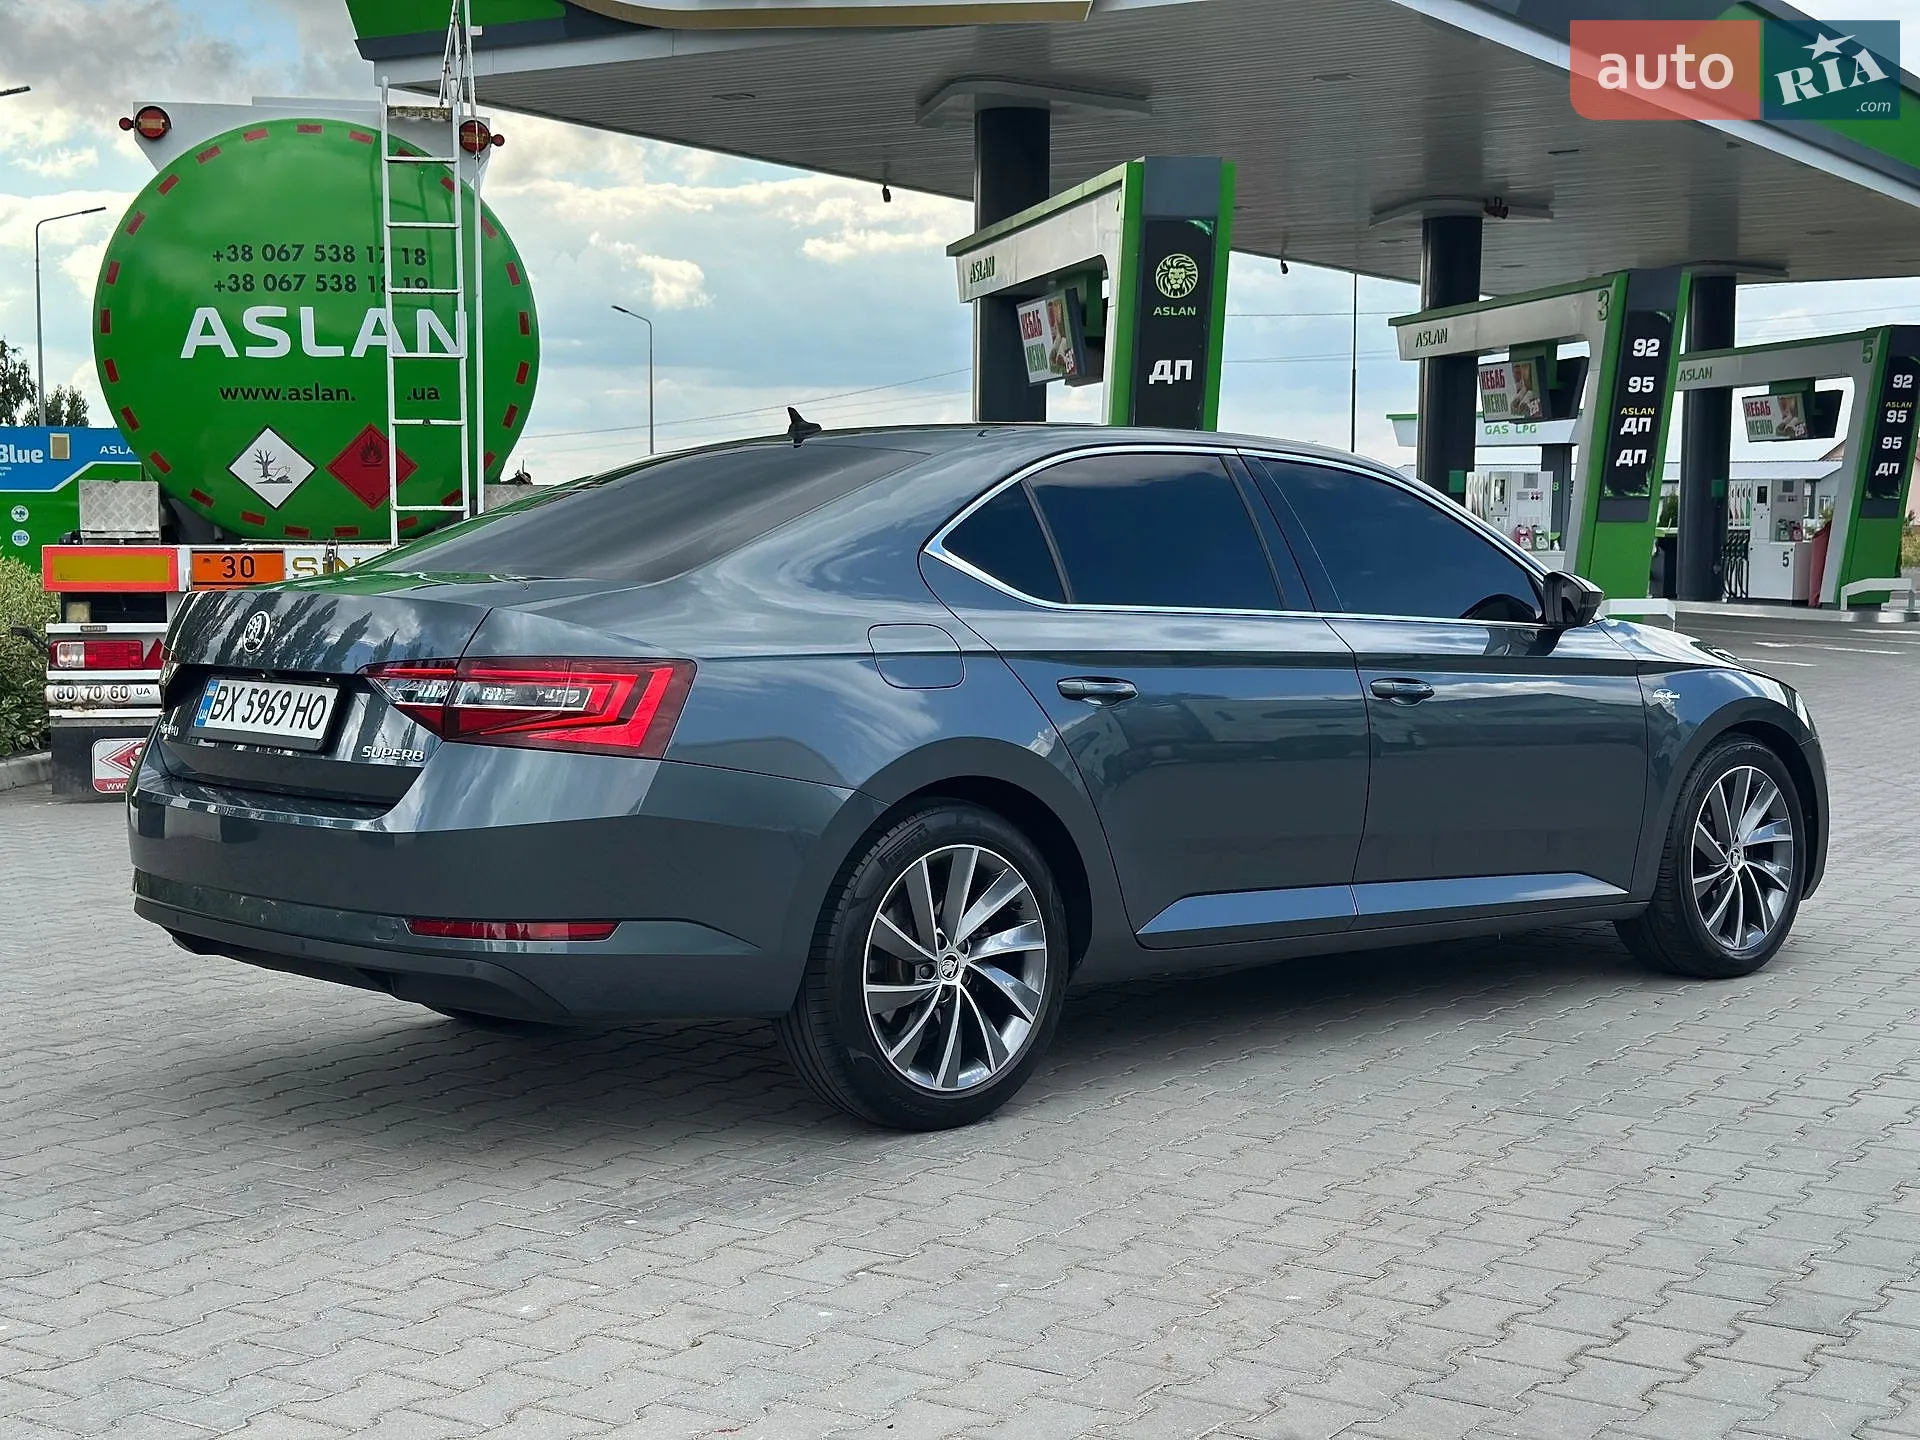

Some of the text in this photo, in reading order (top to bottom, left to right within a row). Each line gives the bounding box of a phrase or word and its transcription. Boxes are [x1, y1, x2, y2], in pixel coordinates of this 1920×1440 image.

[212, 243, 254, 263] +38
[262, 243, 304, 263] 067
[314, 244, 356, 264] 538
[401, 247, 427, 266] 18
[969, 255, 995, 284] ASLAN
[214, 273, 255, 293] +38
[263, 273, 306, 293] 067
[315, 274, 357, 293] 538
[1152, 306, 1197, 316] ASLAN
[1597, 289, 1609, 321] 3
[180, 305, 468, 360] ASLAN
[1020, 309, 1043, 341] КЕБАБ
[1415, 327, 1449, 348] ASLAN
[1632, 338, 1661, 357] 92
[1862, 340, 1874, 364] 5
[1025, 343, 1049, 372] МЕНЮ
[1149, 359, 1193, 385] ДП
[1480, 368, 1506, 391] КЕБАБ
[1679, 366, 1713, 382] ASLAN
[1627, 376, 1655, 393] 95
[1892, 374, 1914, 389] 92
[1483, 393, 1509, 415] МЕНЮ
[1620, 407, 1655, 416] ASLAN
[1745, 401, 1771, 418] КЕБАБ
[1885, 401, 1913, 409] ASLAN
[1886, 410, 1908, 423] 95
[1484, 423, 1537, 435] GAS LPG
[1619, 417, 1652, 435] ДП
[1747, 418, 1773, 436] МЕНЮ
[99, 445, 135, 455] ASLA
[1881, 436, 1903, 450] 95
[1615, 449, 1648, 467] ДП
[1875, 462, 1900, 476] ДП
[220, 555, 255, 579] 30
[1782, 551, 1790, 567] 5
[56, 685, 129, 700] 80 70 60
[136, 687, 151, 696] UA
[210, 686, 327, 732] BX 5969 HO
[361, 745, 425, 762] SUPERB
